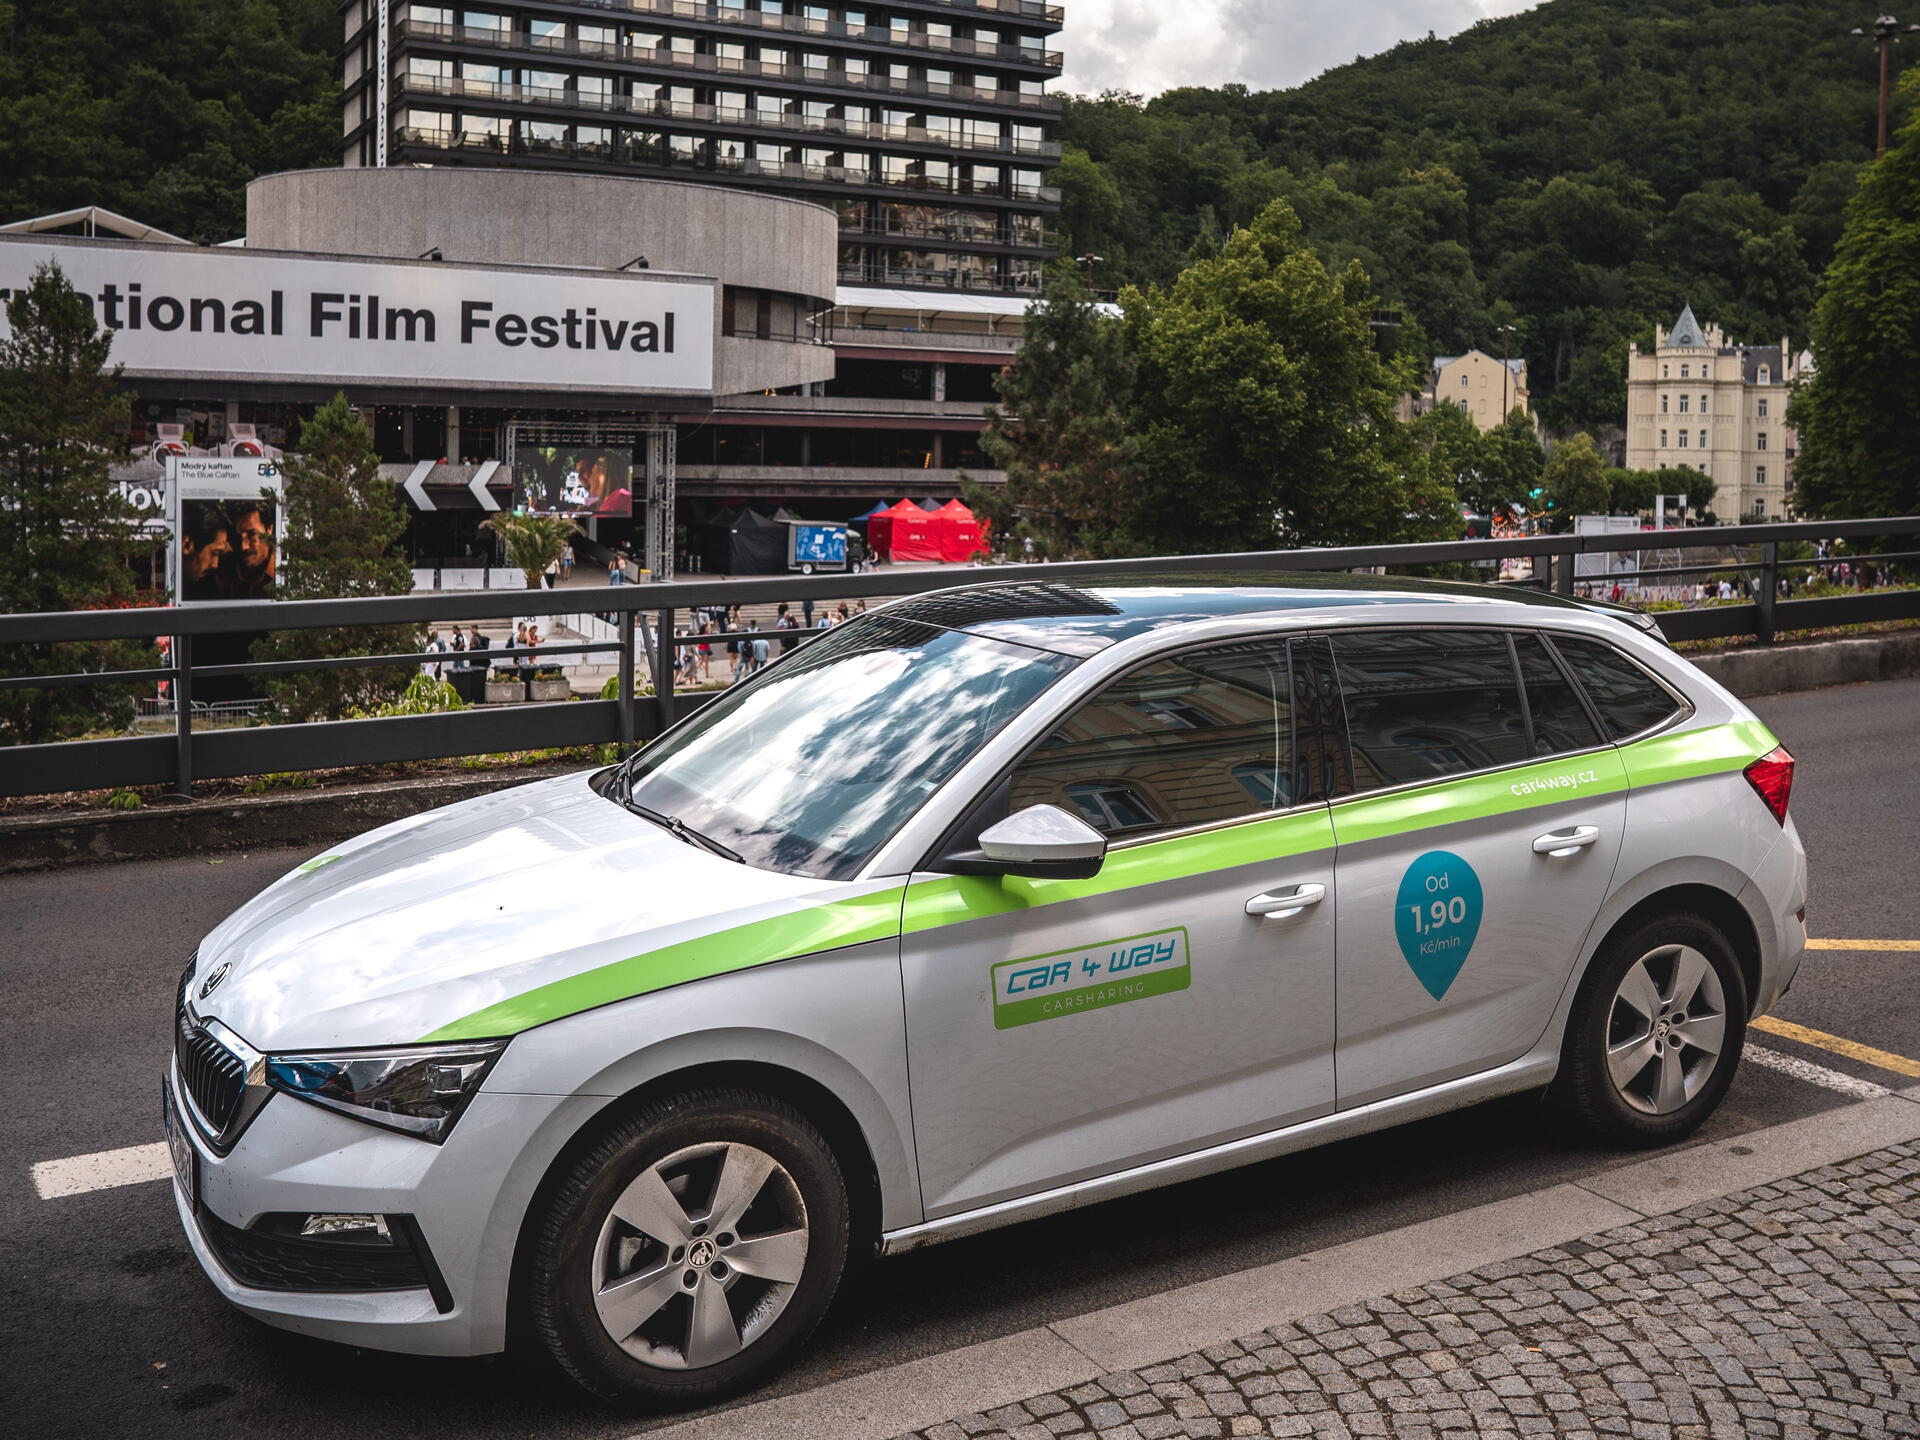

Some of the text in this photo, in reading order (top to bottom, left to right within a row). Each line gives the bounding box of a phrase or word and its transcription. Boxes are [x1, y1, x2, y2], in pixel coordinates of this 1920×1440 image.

[0, 282, 675, 353] tional Film Festival
[208, 462, 232, 470] kaftan
[257, 463, 277, 477] 56
[1510, 769, 1599, 796] car4way.cz
[1425, 872, 1449, 892] Od
[1411, 896, 1466, 935] 1,90
[1420, 935, 1461, 956] Kč/min
[1081, 957, 1101, 978] 4
[1042, 982, 1145, 1013] CARSHARING
